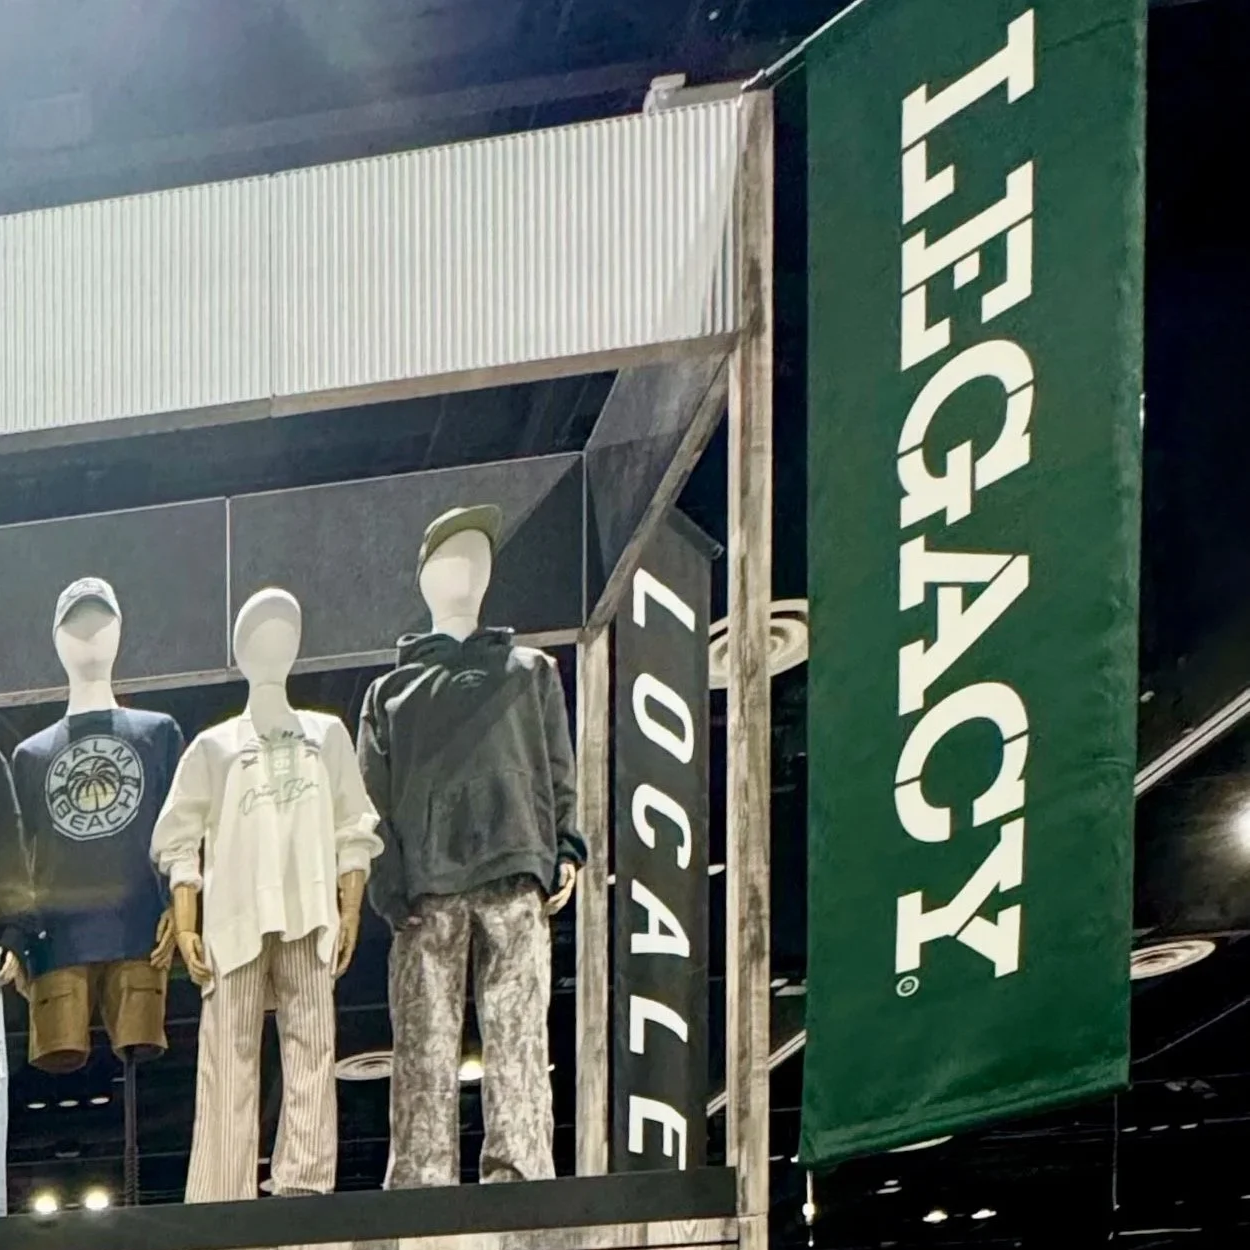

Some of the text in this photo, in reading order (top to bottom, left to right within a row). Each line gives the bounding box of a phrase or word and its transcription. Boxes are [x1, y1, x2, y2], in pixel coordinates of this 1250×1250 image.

[893, 9, 1035, 978] LEGACY
[53, 740, 134, 778] PALM
[55, 788, 135, 832] BEACH
[628, 567, 696, 1171] LOCALE
